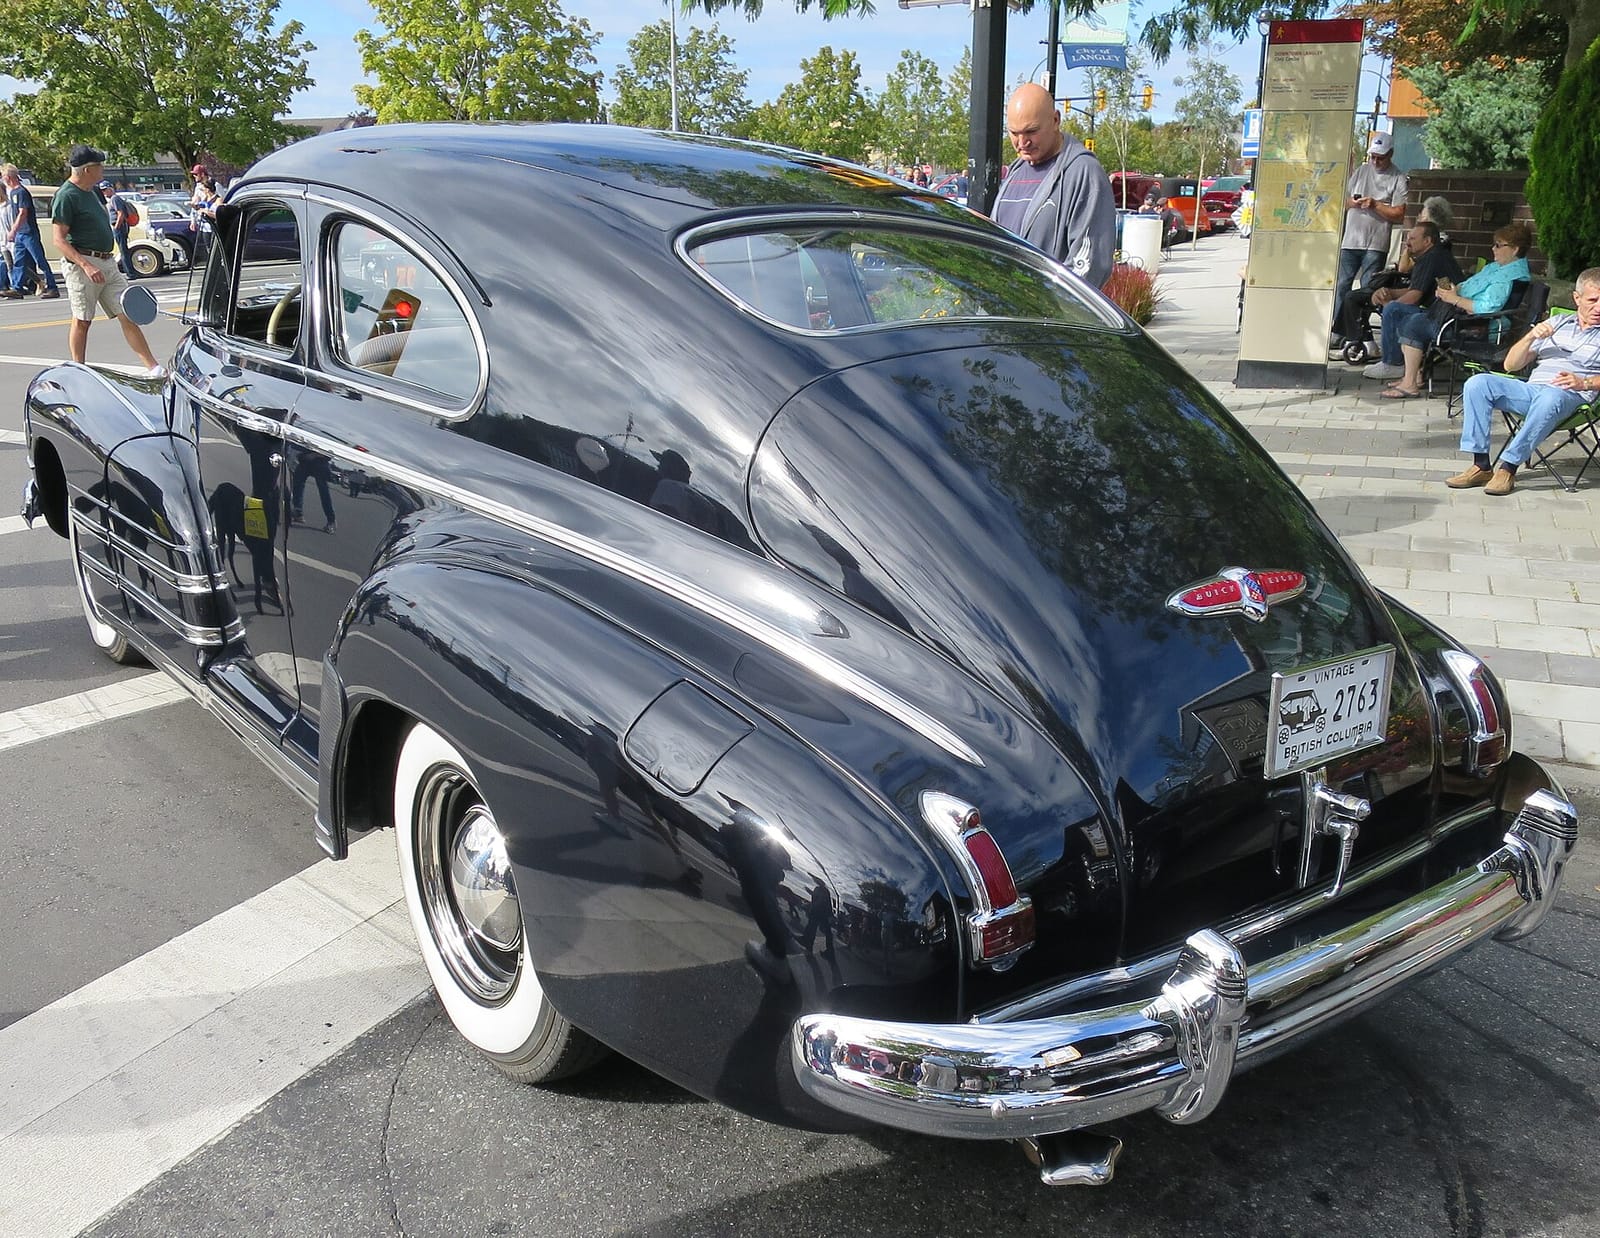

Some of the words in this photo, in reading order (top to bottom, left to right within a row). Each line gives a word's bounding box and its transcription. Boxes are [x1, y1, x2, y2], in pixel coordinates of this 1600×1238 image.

[1072, 54, 1121, 62] LANGLEY
[1195, 584, 1236, 601] BUICK
[1314, 663, 1355, 684] VINTAGE
[1332, 678, 1379, 722] 2763
[1284, 737, 1323, 759] BRITISH
[1326, 720, 1373, 745] COLUMBIA
